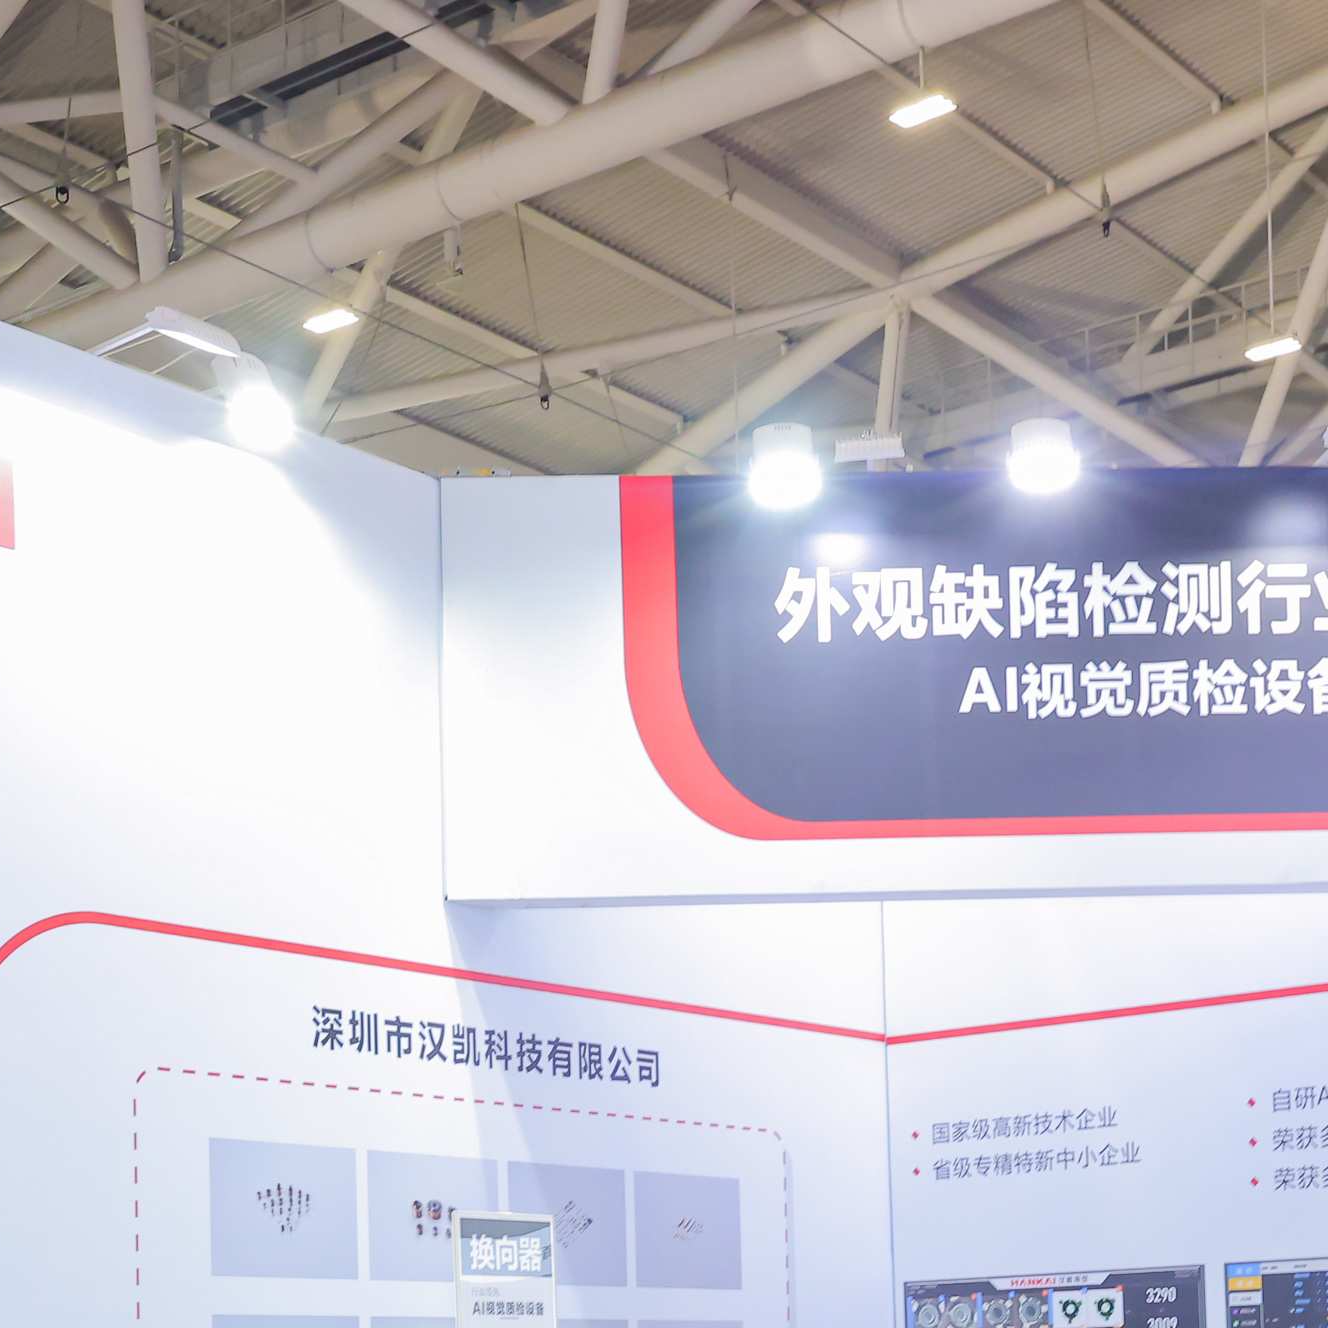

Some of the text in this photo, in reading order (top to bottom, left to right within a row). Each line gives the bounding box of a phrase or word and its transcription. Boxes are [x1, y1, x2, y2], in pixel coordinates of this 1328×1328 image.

[311, 1004, 661, 1087] 深圳市汉凯科技有限公司
[932, 1105, 1118, 1144] 国家级高新技术企业
[933, 1141, 1142, 1180] 省级专精特新中小企业
[470, 1233, 543, 1273] 换向器
